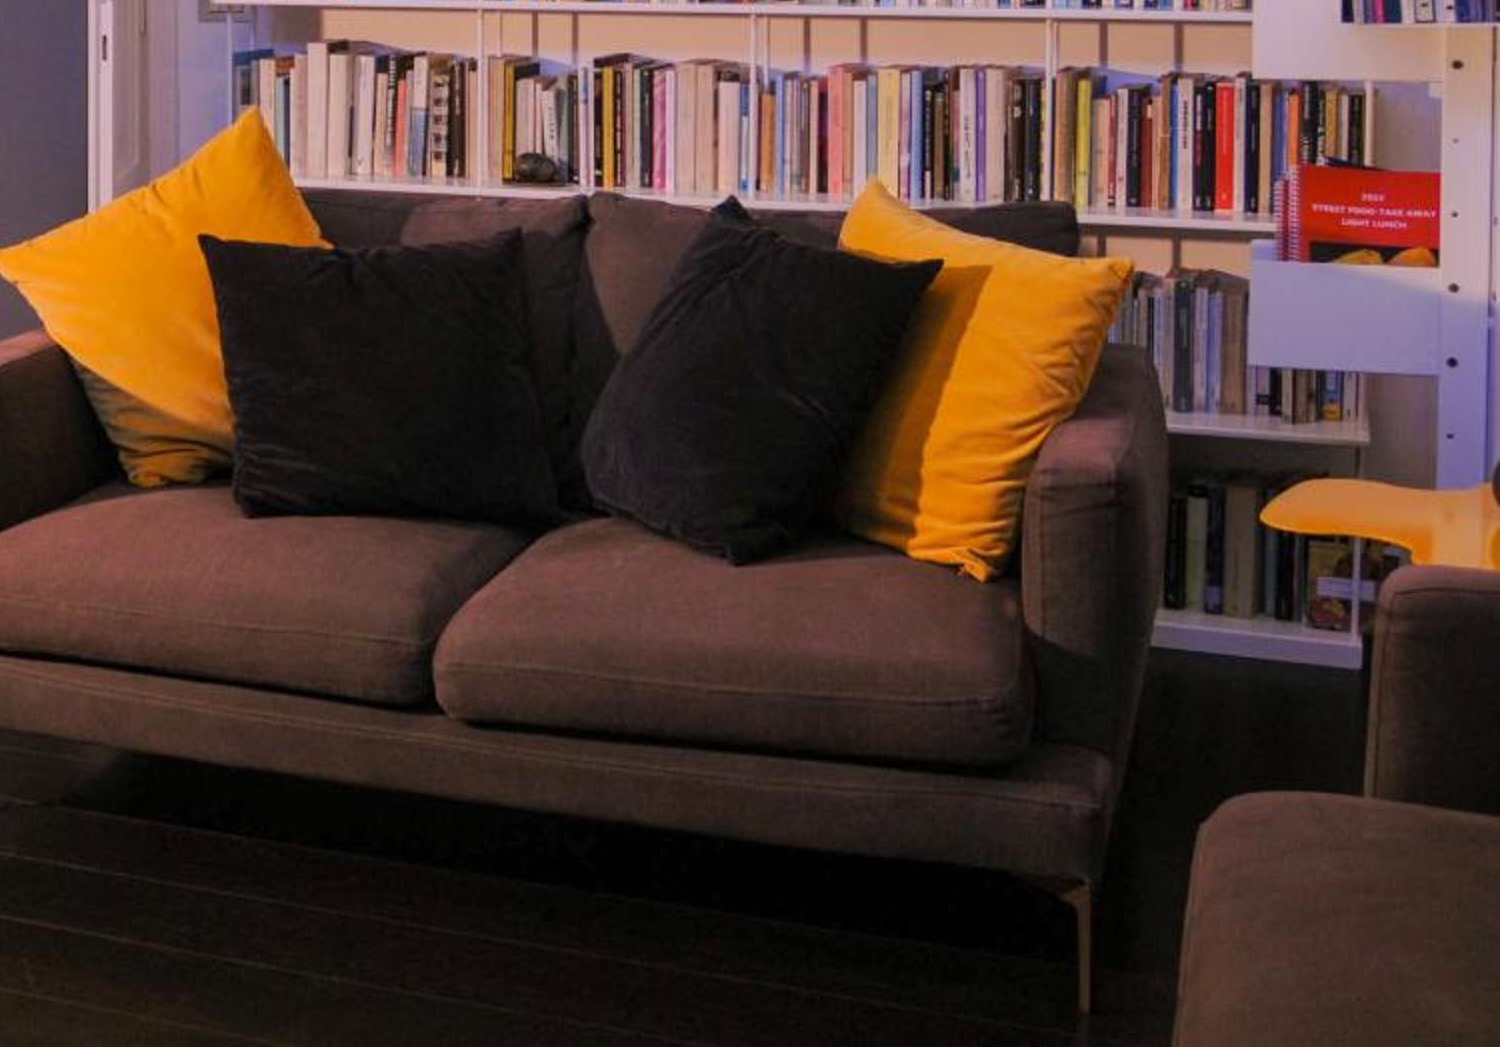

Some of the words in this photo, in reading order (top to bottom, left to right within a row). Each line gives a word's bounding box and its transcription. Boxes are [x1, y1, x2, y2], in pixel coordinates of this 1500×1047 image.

[1311, 203, 1345, 214] STREET
[1405, 208, 1437, 218] AWAY
[1341, 217, 1370, 228] LIGHT
[1371, 219, 1408, 230] LUNCH
